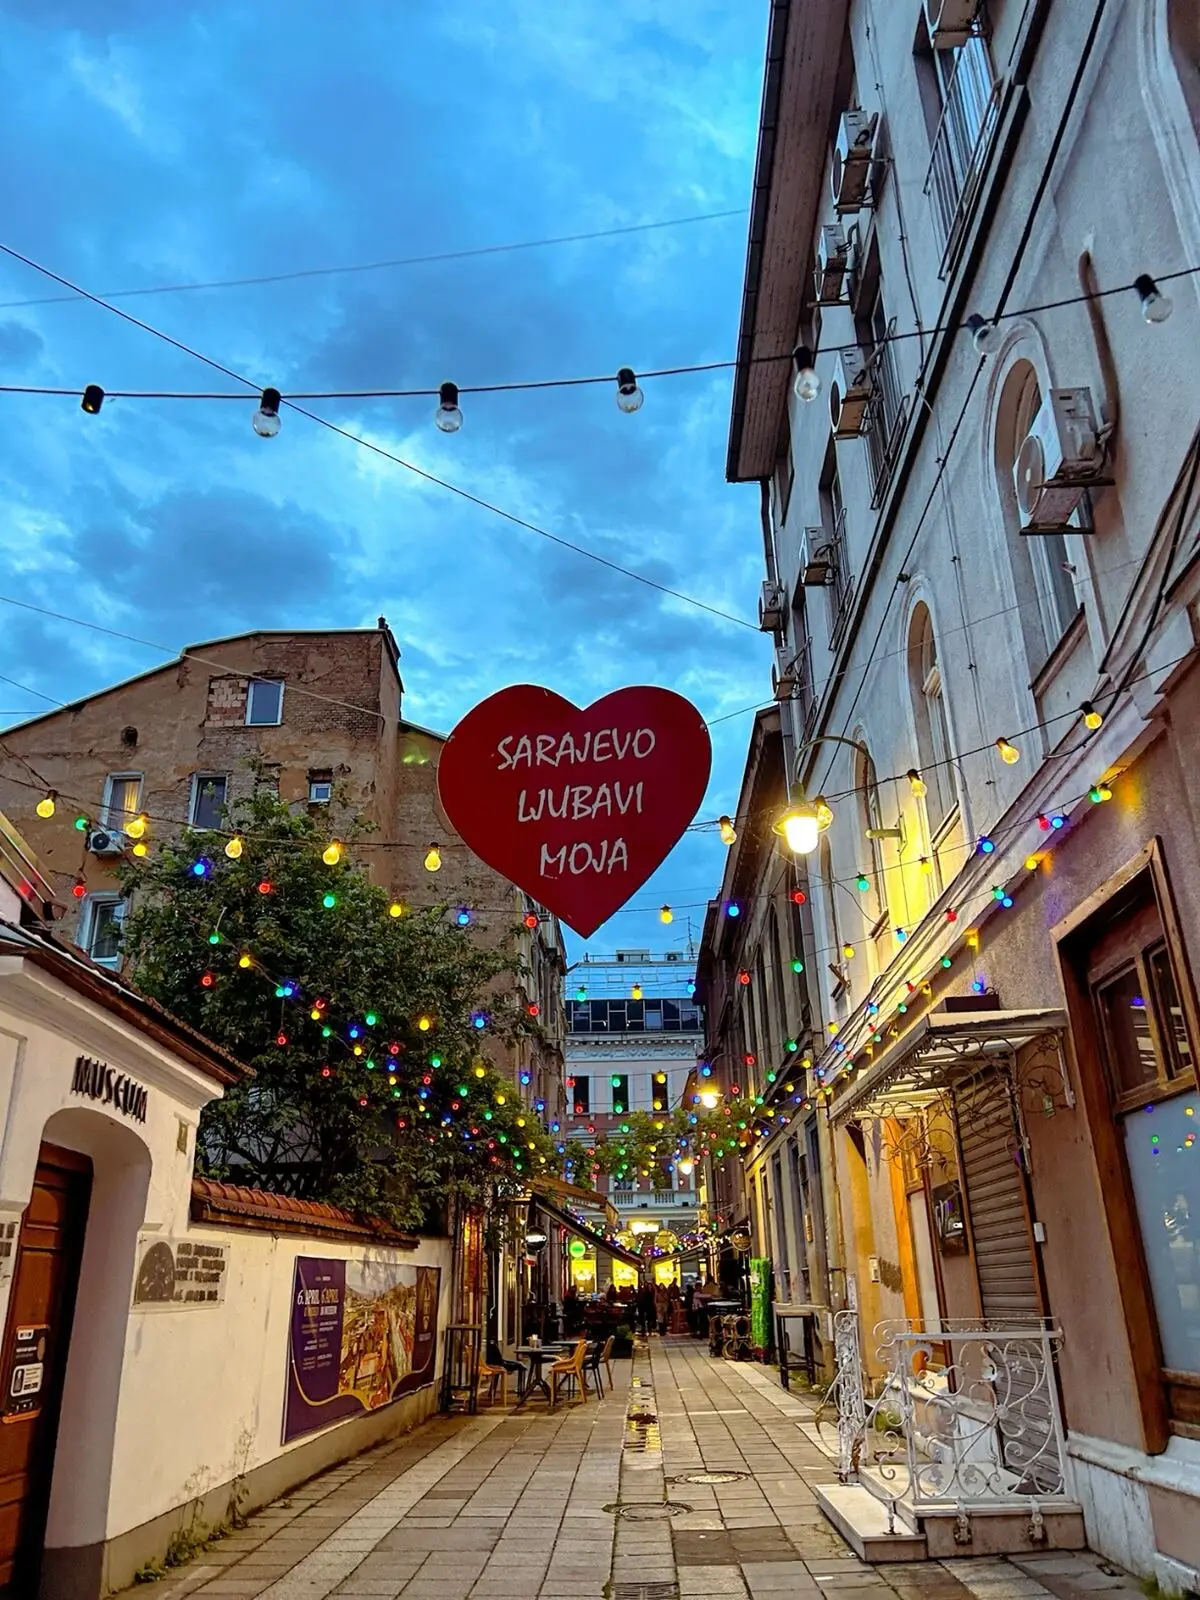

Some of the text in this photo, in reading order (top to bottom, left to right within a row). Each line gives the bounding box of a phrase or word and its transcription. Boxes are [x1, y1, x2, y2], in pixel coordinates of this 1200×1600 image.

[497, 728, 656, 770] SARAJEVO
[518, 781, 643, 822] LJUBAVI
[540, 837, 628, 876] MOJA
[71, 1055, 148, 1125] MUSEUM
